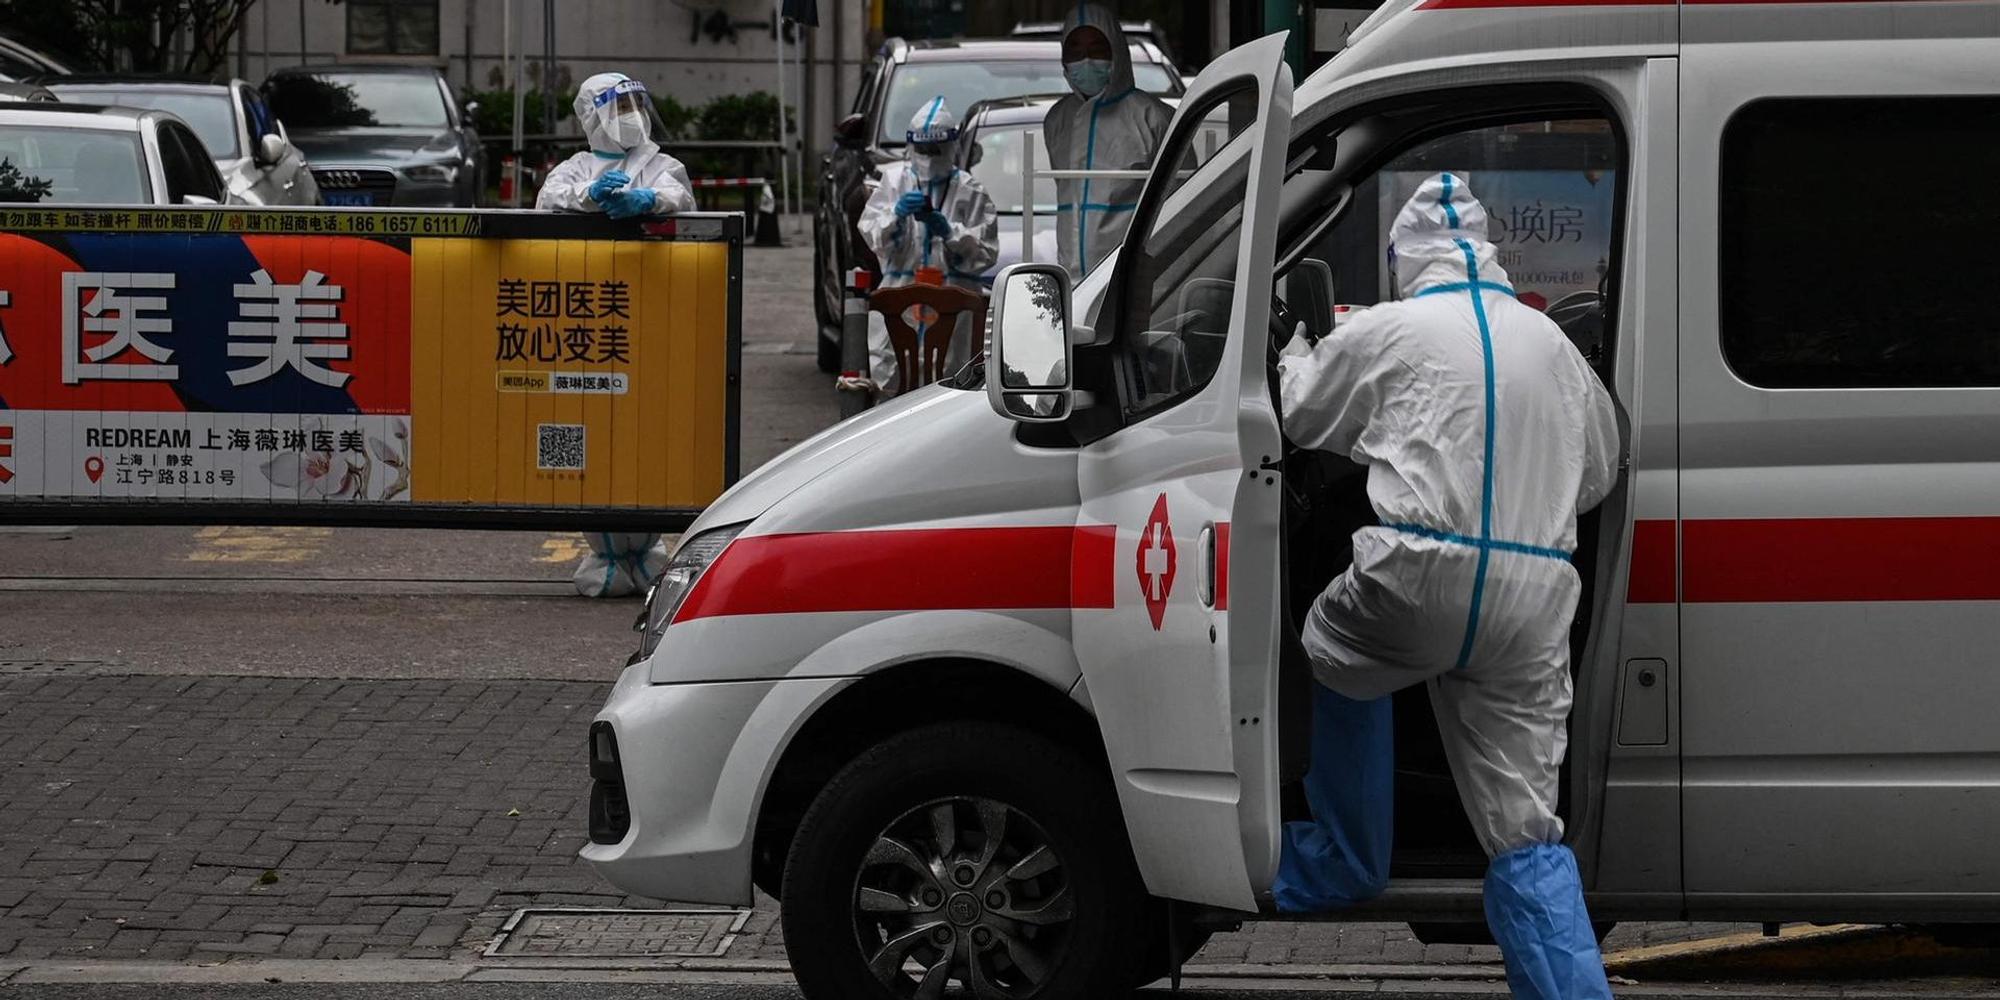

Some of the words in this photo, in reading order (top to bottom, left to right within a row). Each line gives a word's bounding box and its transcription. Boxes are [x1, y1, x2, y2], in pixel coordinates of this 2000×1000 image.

[64, 212, 131, 229] 如若撞杆
[137, 213, 205, 230] 照价赔偿
[346, 216, 375, 232] 186
[380, 216, 418, 232] 1657
[423, 217, 458, 233] 6111
[496, 278, 630, 320] 美团医美
[0, 268, 350, 388] 医美
[495, 322, 630, 365] 放心变美
[85, 427, 192, 449] REDREAM
[198, 427, 365, 453] 上海薇琳医美
[115, 453, 143, 467] 上海
[165, 453, 194, 467] 静安
[115, 468, 236, 486] 江宁路818号
